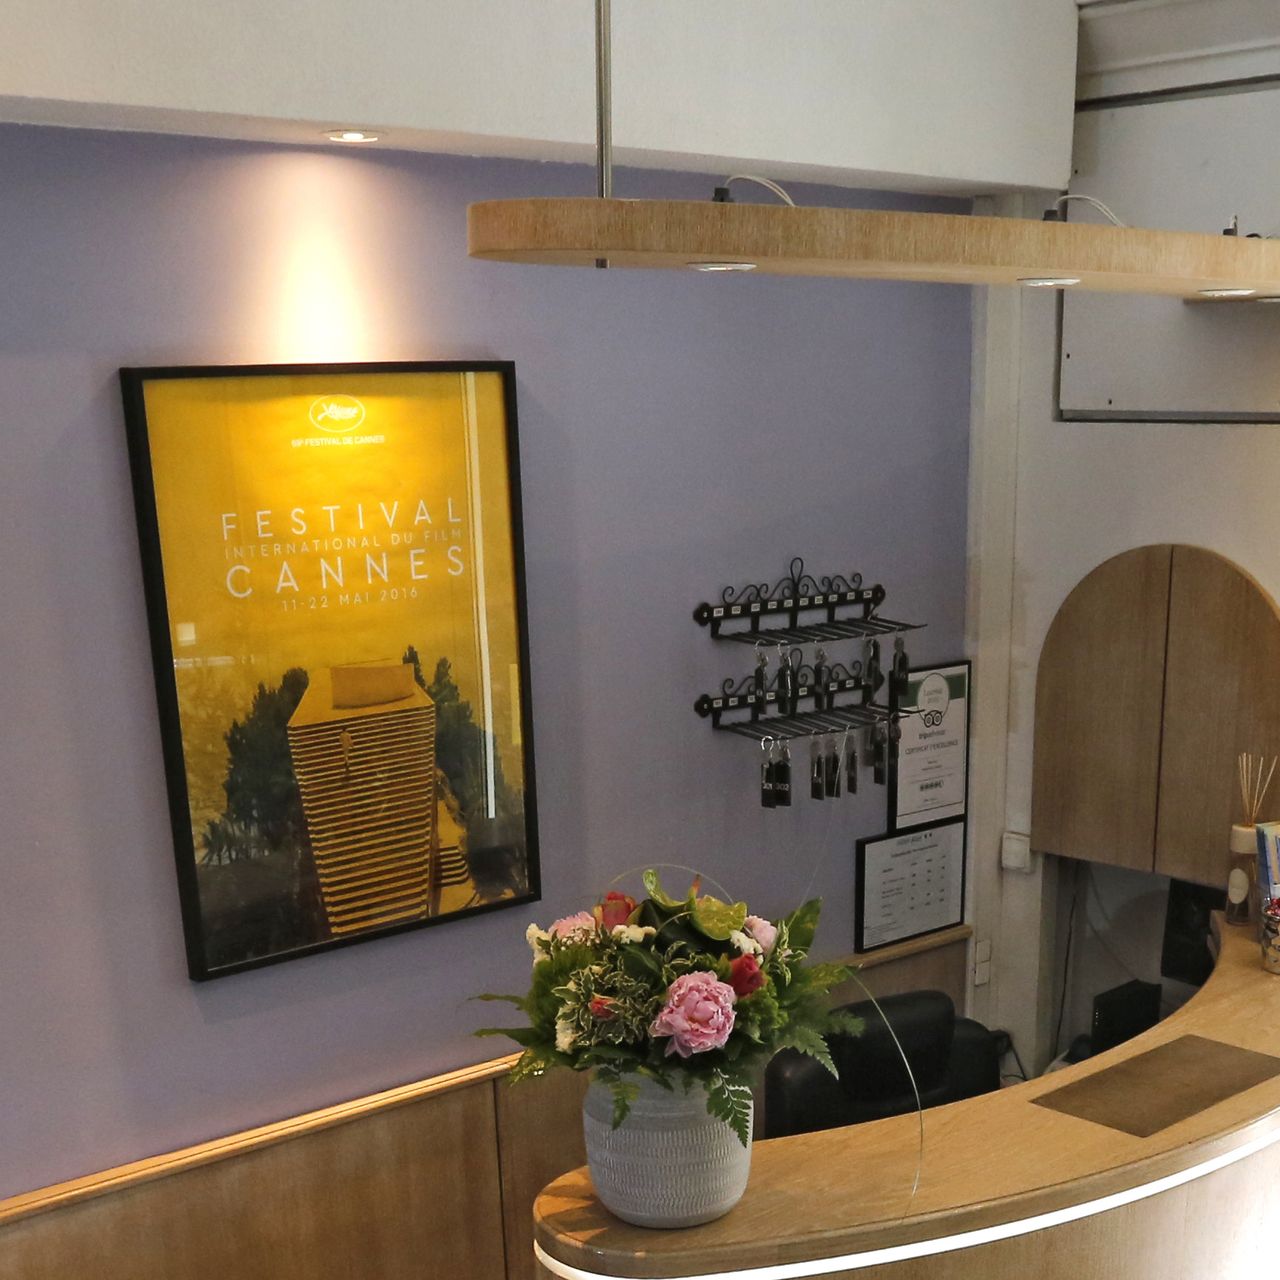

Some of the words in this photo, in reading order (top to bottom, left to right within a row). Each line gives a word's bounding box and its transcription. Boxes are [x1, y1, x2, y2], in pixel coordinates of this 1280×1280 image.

[305, 437, 341, 447] FESTIVAL
[342, 435, 354, 446] DE
[354, 434, 385, 446] CANNES
[222, 497, 461, 540] FESTIVAL
[225, 536, 380, 560] INTERNATIONAL
[391, 532, 413, 546] DU
[424, 528, 462, 542] FILM
[226, 546, 464, 598] CANNES
[282, 596, 329, 612] 11-22
[340, 592, 369, 605] MAI
[380, 587, 418, 602] 2016
